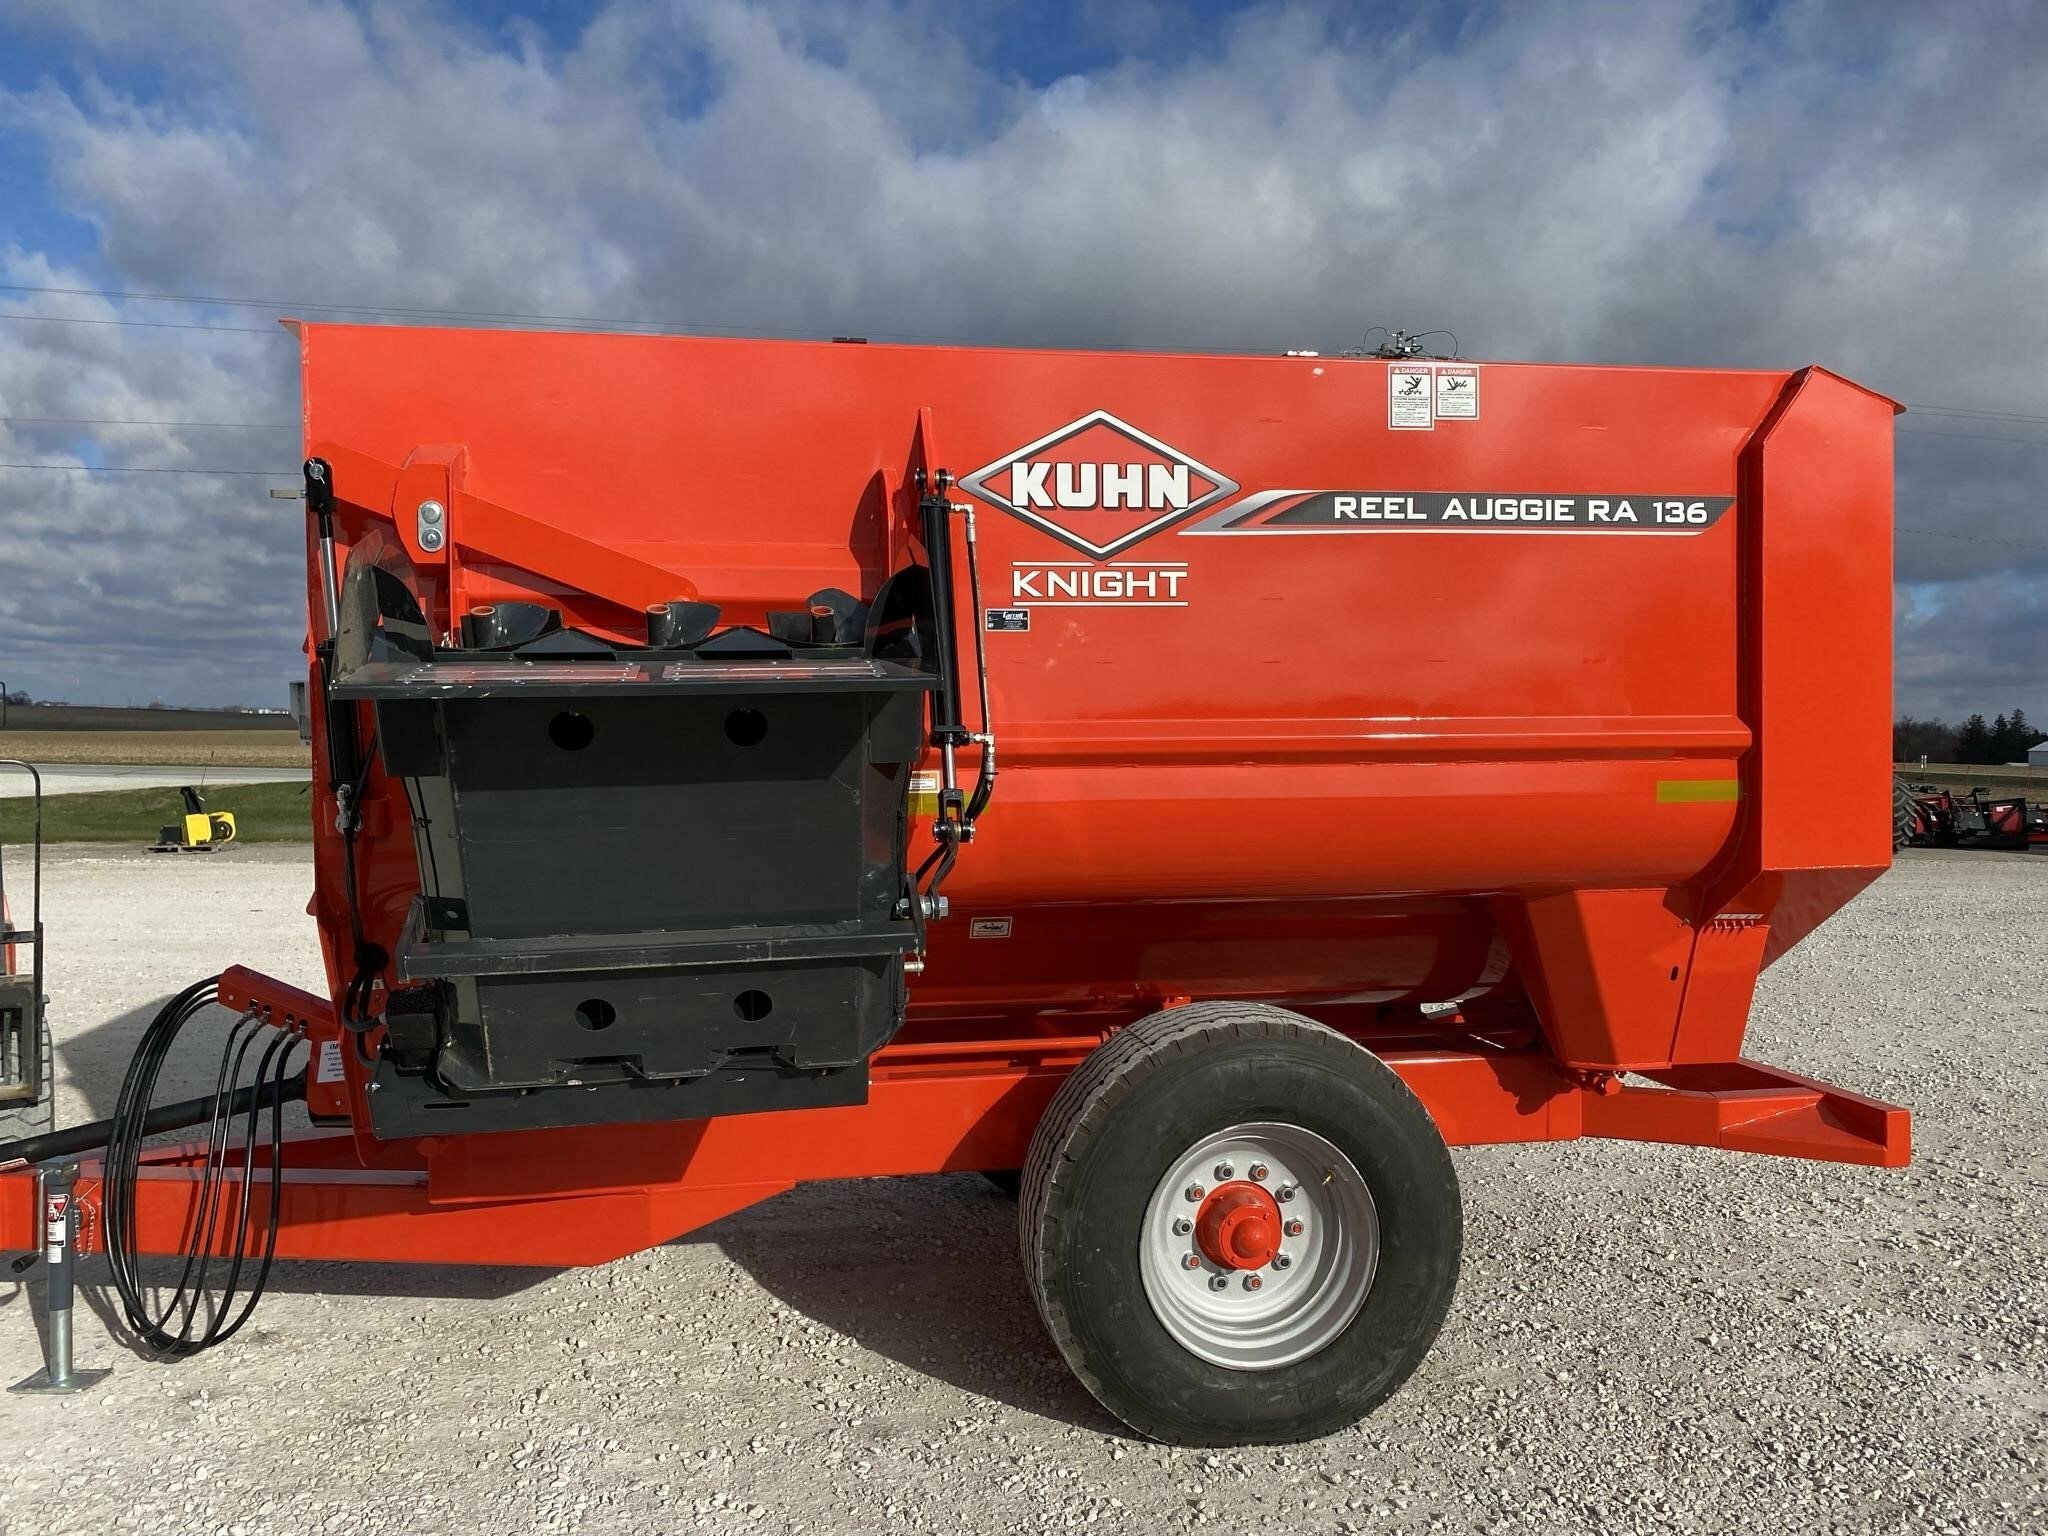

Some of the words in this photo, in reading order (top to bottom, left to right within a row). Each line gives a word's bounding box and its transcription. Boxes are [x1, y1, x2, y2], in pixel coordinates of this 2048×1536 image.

[1011, 462, 1189, 509] KUHN
[1333, 496, 1428, 520] REEL
[1441, 497, 1575, 521] AUGGIE
[1588, 499, 1639, 522] RA
[1652, 501, 1708, 524] 136
[1012, 570, 1188, 598] KNIGHT
